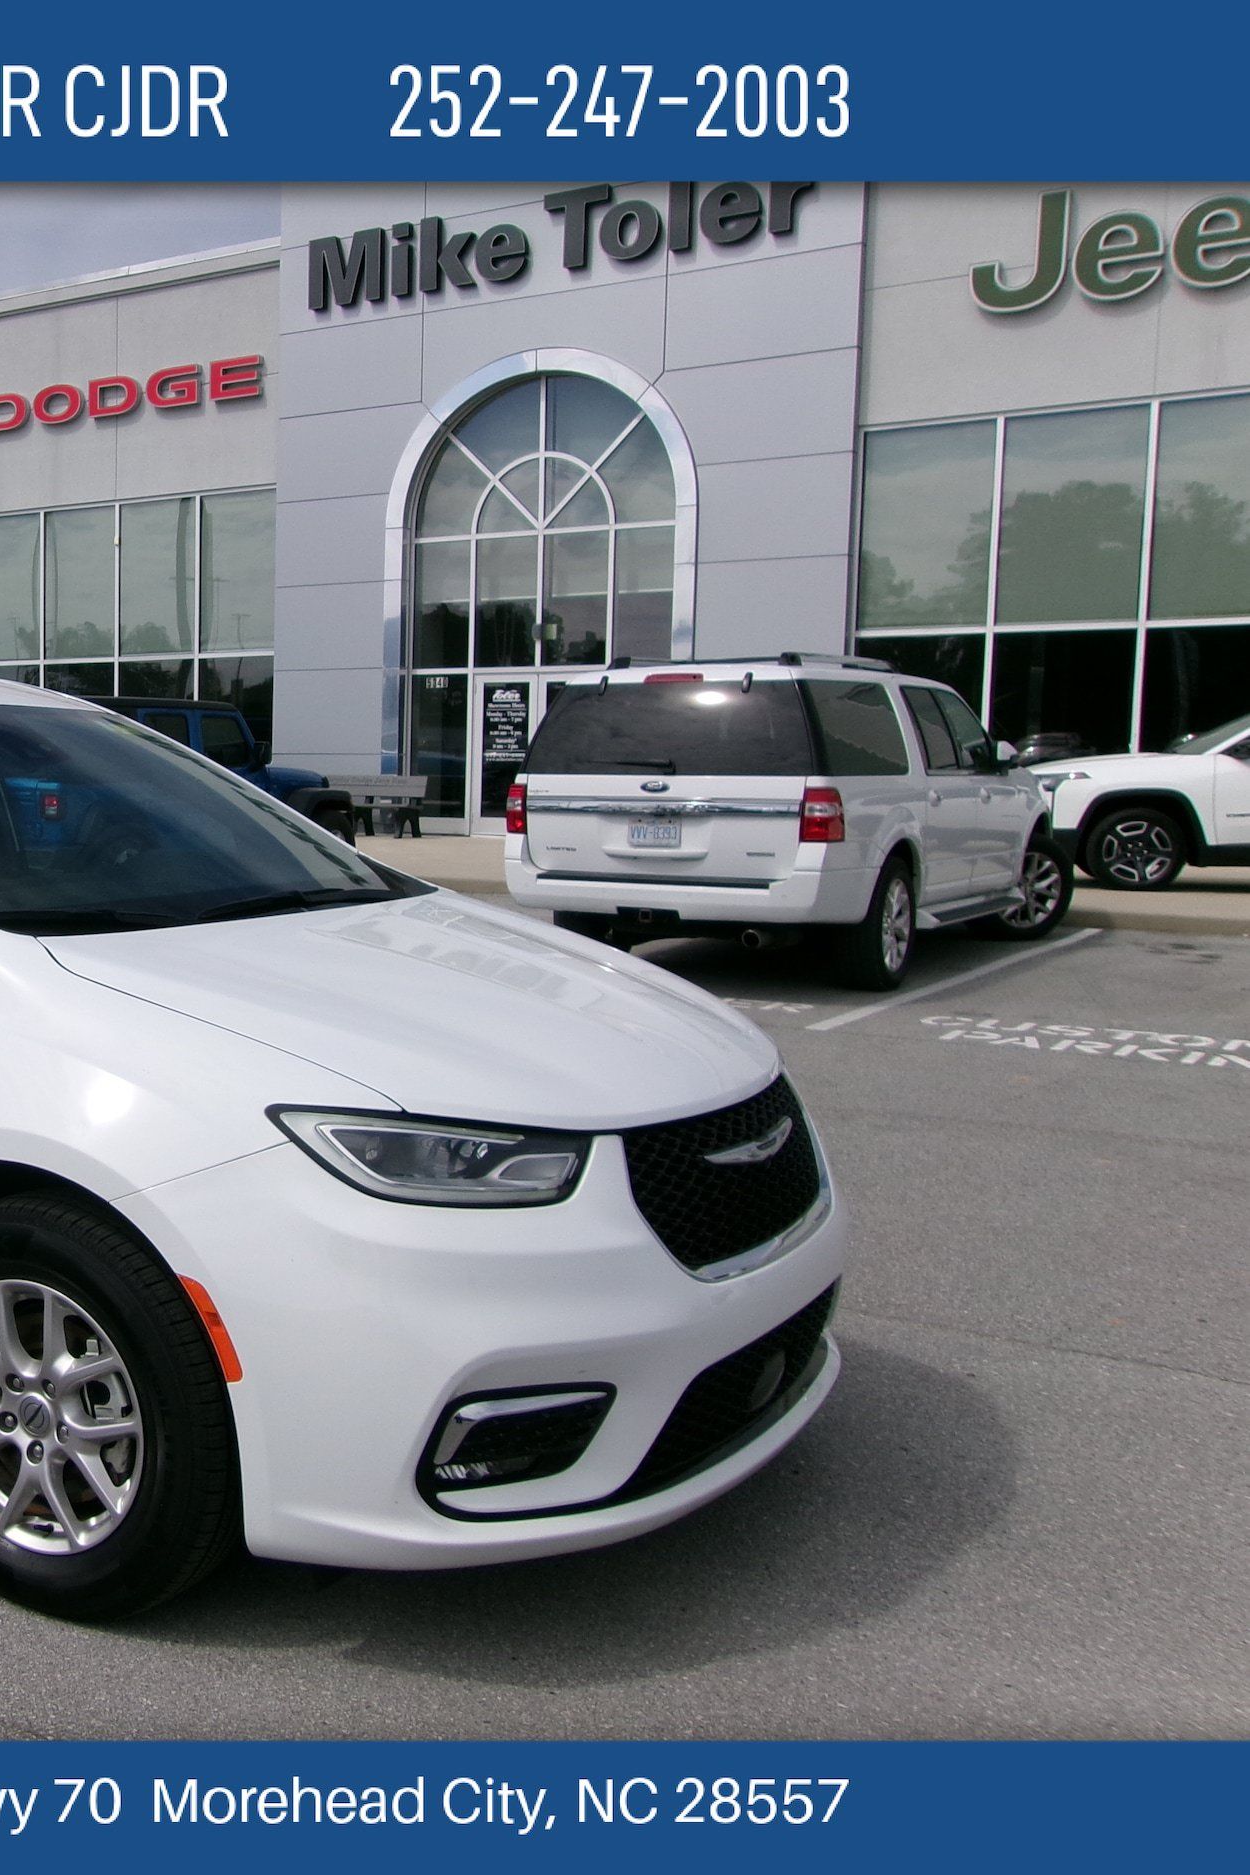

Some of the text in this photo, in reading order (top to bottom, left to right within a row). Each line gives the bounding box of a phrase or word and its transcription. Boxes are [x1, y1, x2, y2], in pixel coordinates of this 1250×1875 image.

[308, 181, 815, 311] Mike Toler
[969, 189, 1250, 312] Jee
